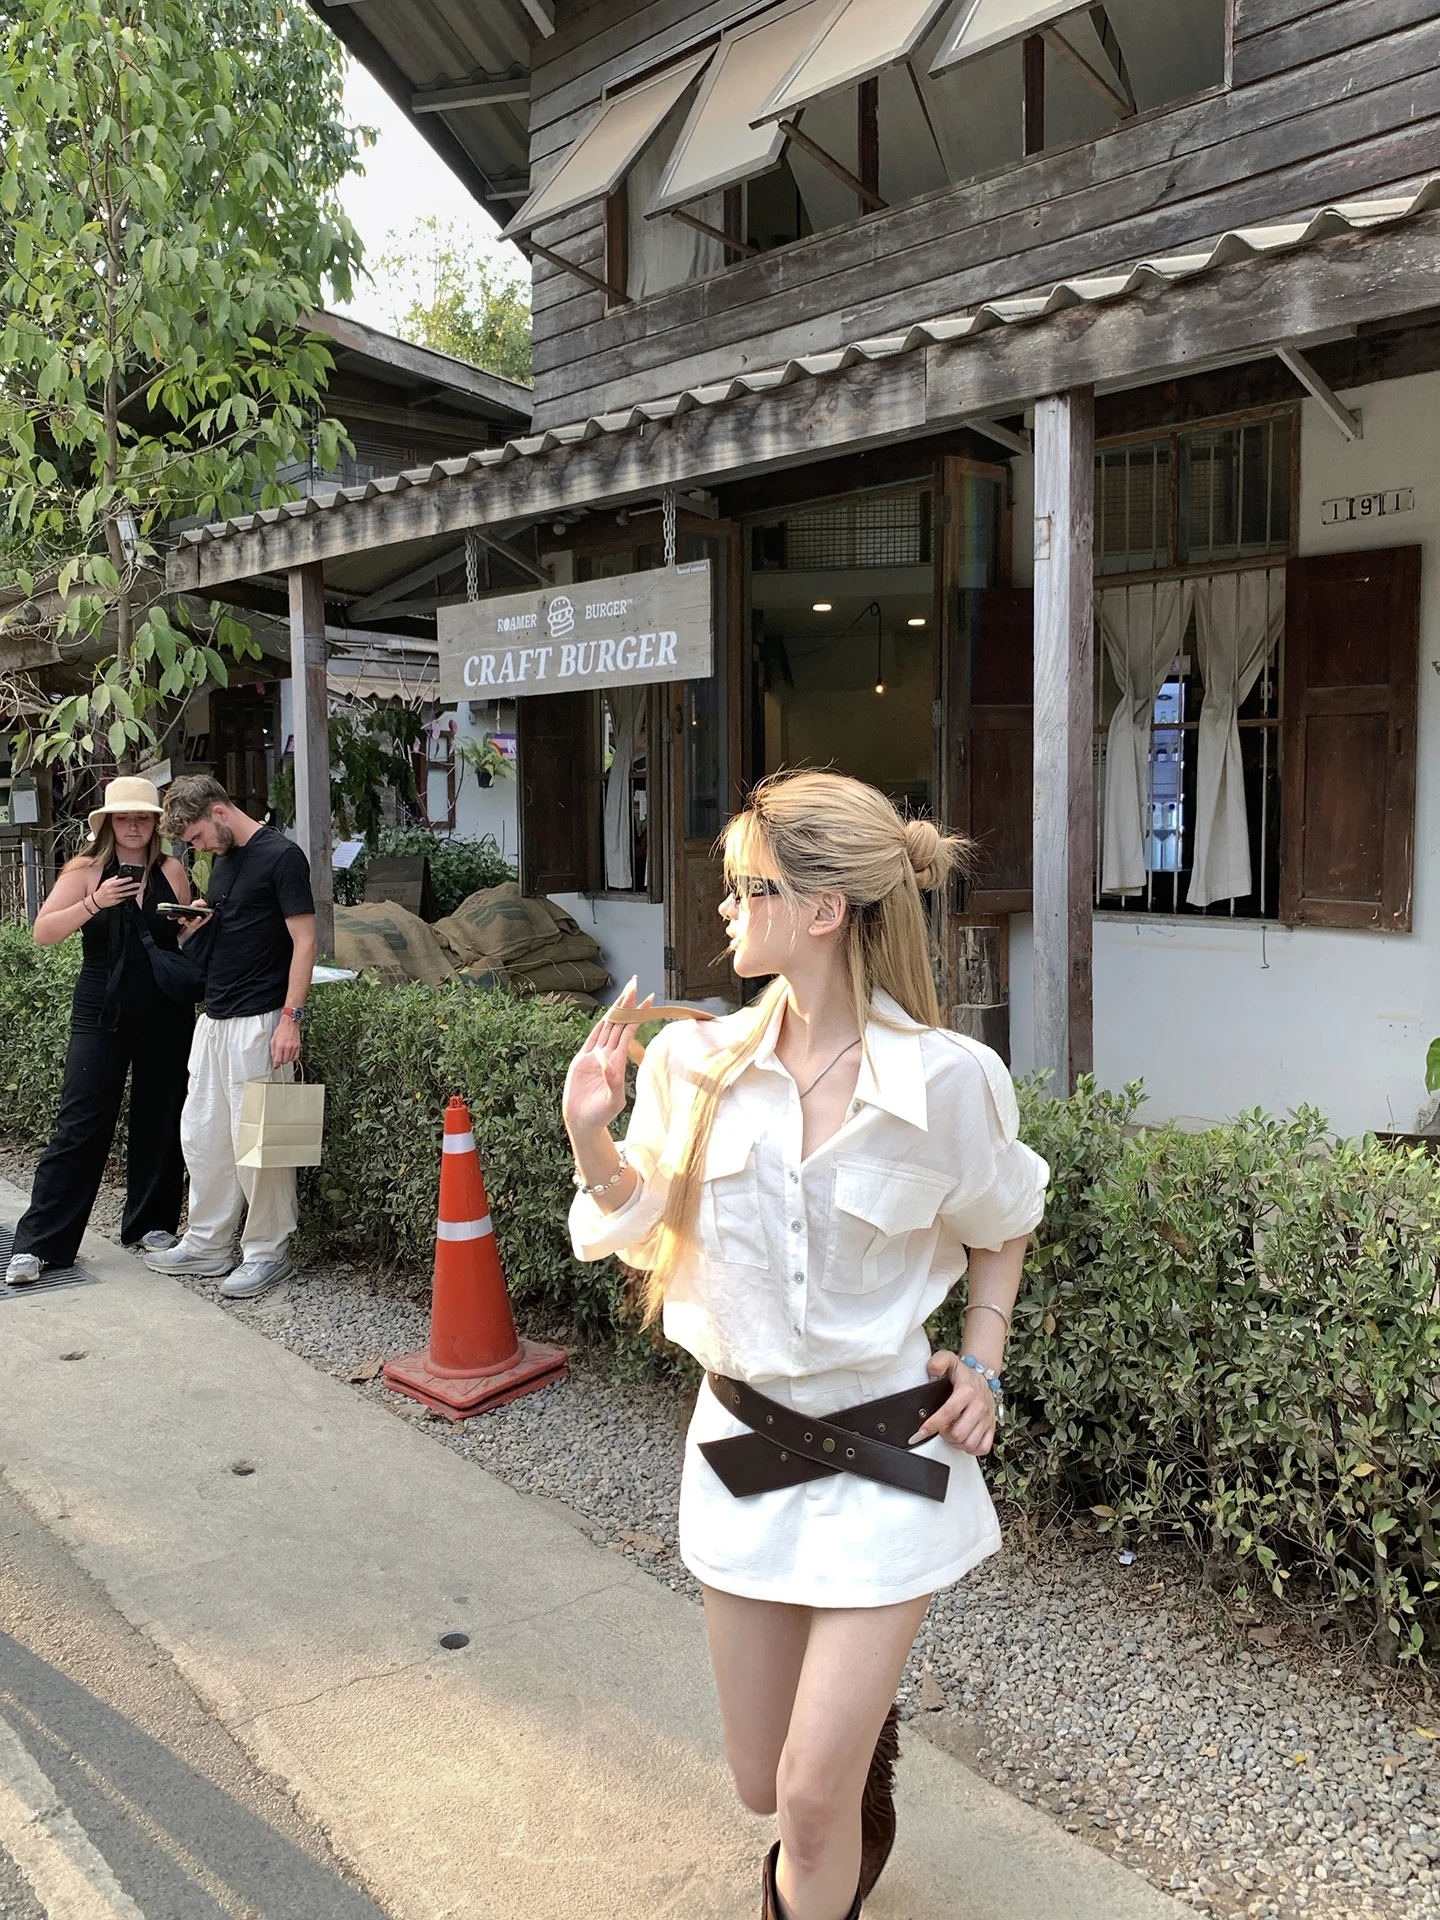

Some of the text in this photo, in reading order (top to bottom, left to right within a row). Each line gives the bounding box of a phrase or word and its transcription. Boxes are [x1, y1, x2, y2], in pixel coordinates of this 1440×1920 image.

[1333, 493, 1400, 520] 191
[497, 614, 538, 633] ROAMER
[463, 630, 678, 687] CRAFT BURGER
